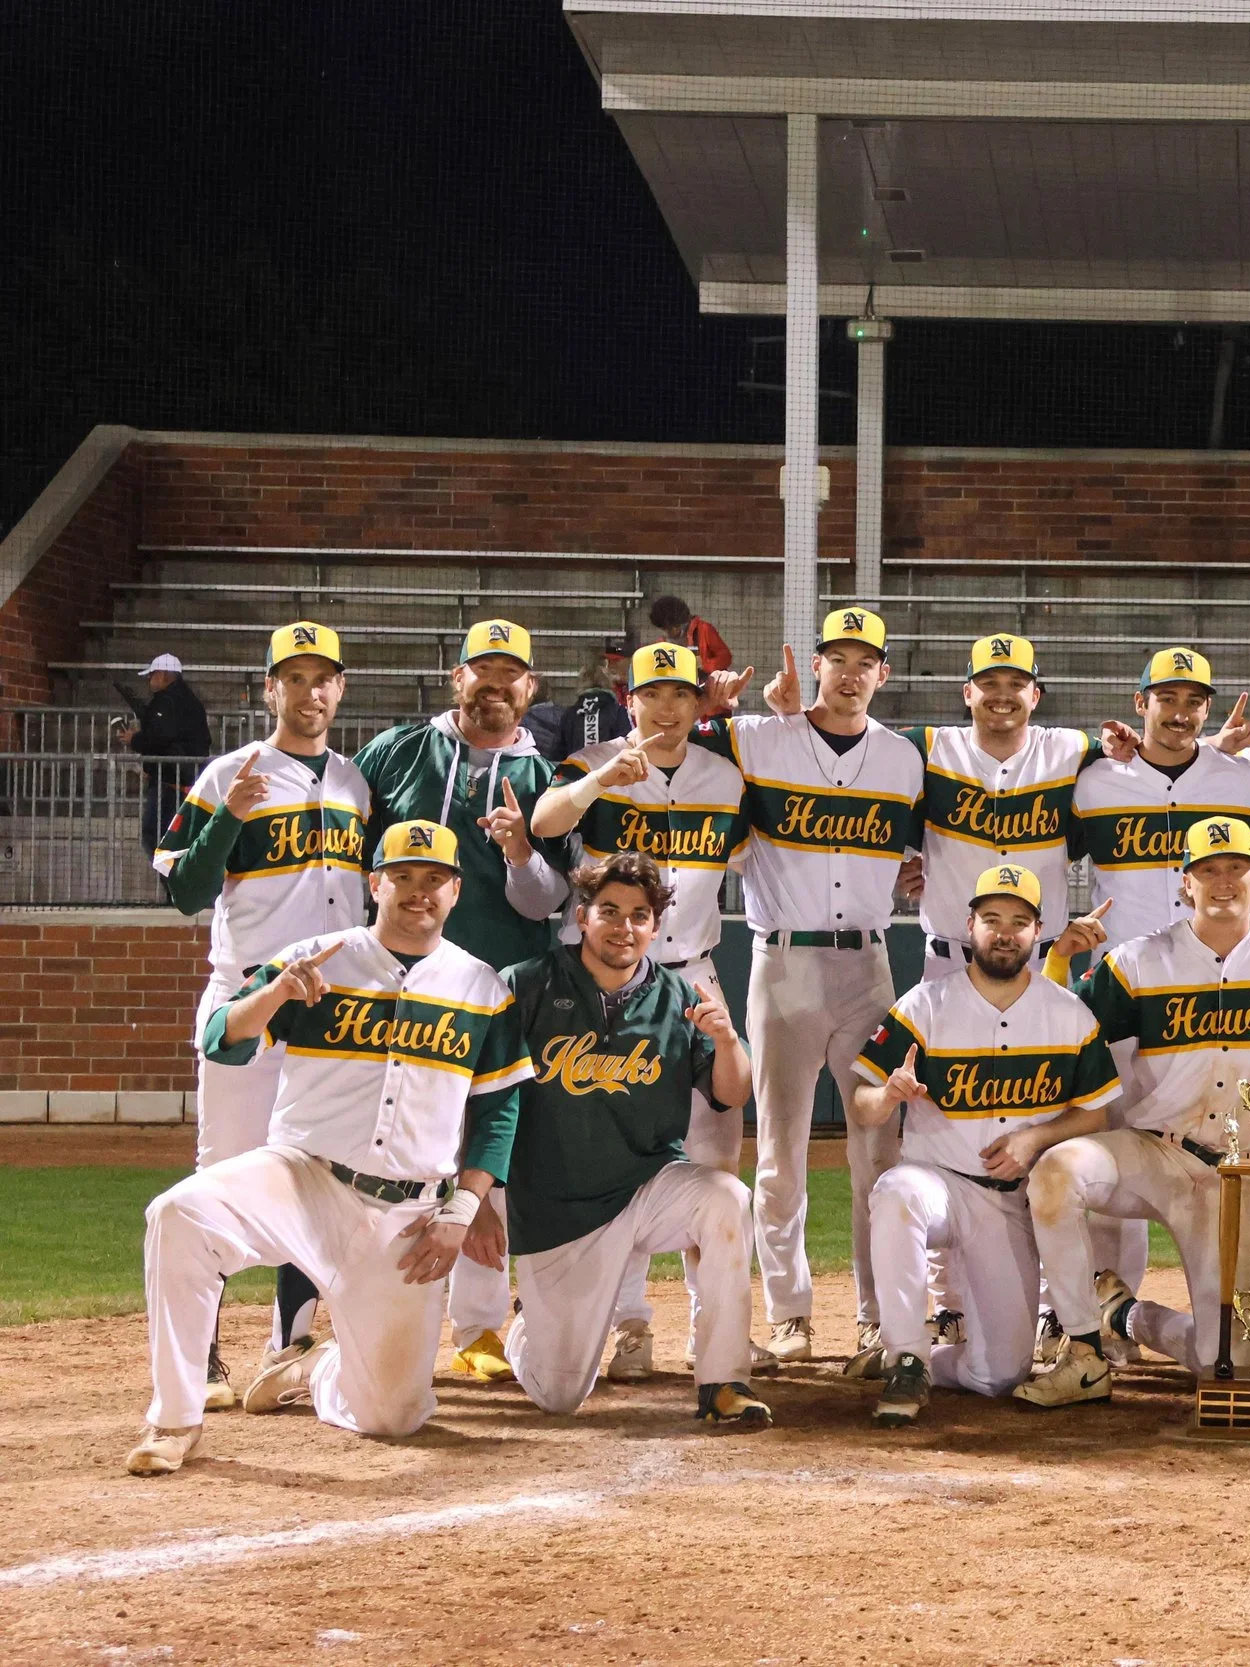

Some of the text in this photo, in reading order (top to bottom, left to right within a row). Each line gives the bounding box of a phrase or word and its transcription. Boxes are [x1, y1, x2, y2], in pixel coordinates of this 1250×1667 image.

[843, 611, 866, 632] N
[292, 626, 318, 647] N
[488, 624, 512, 644] N
[653, 648, 677, 670] N
[991, 638, 1014, 659] N
[1172, 651, 1195, 673] N
[777, 795, 892, 845] Hawks
[947, 787, 1060, 839] Hawks
[408, 825, 435, 849] N
[616, 809, 727, 856] Hawks
[1112, 816, 1190, 858] Haw
[1206, 822, 1233, 847] N
[998, 867, 1021, 888] N
[324, 999, 471, 1059] Hawks
[535, 1030, 662, 1096] Hawks
[940, 1060, 1063, 1109] Hawks
